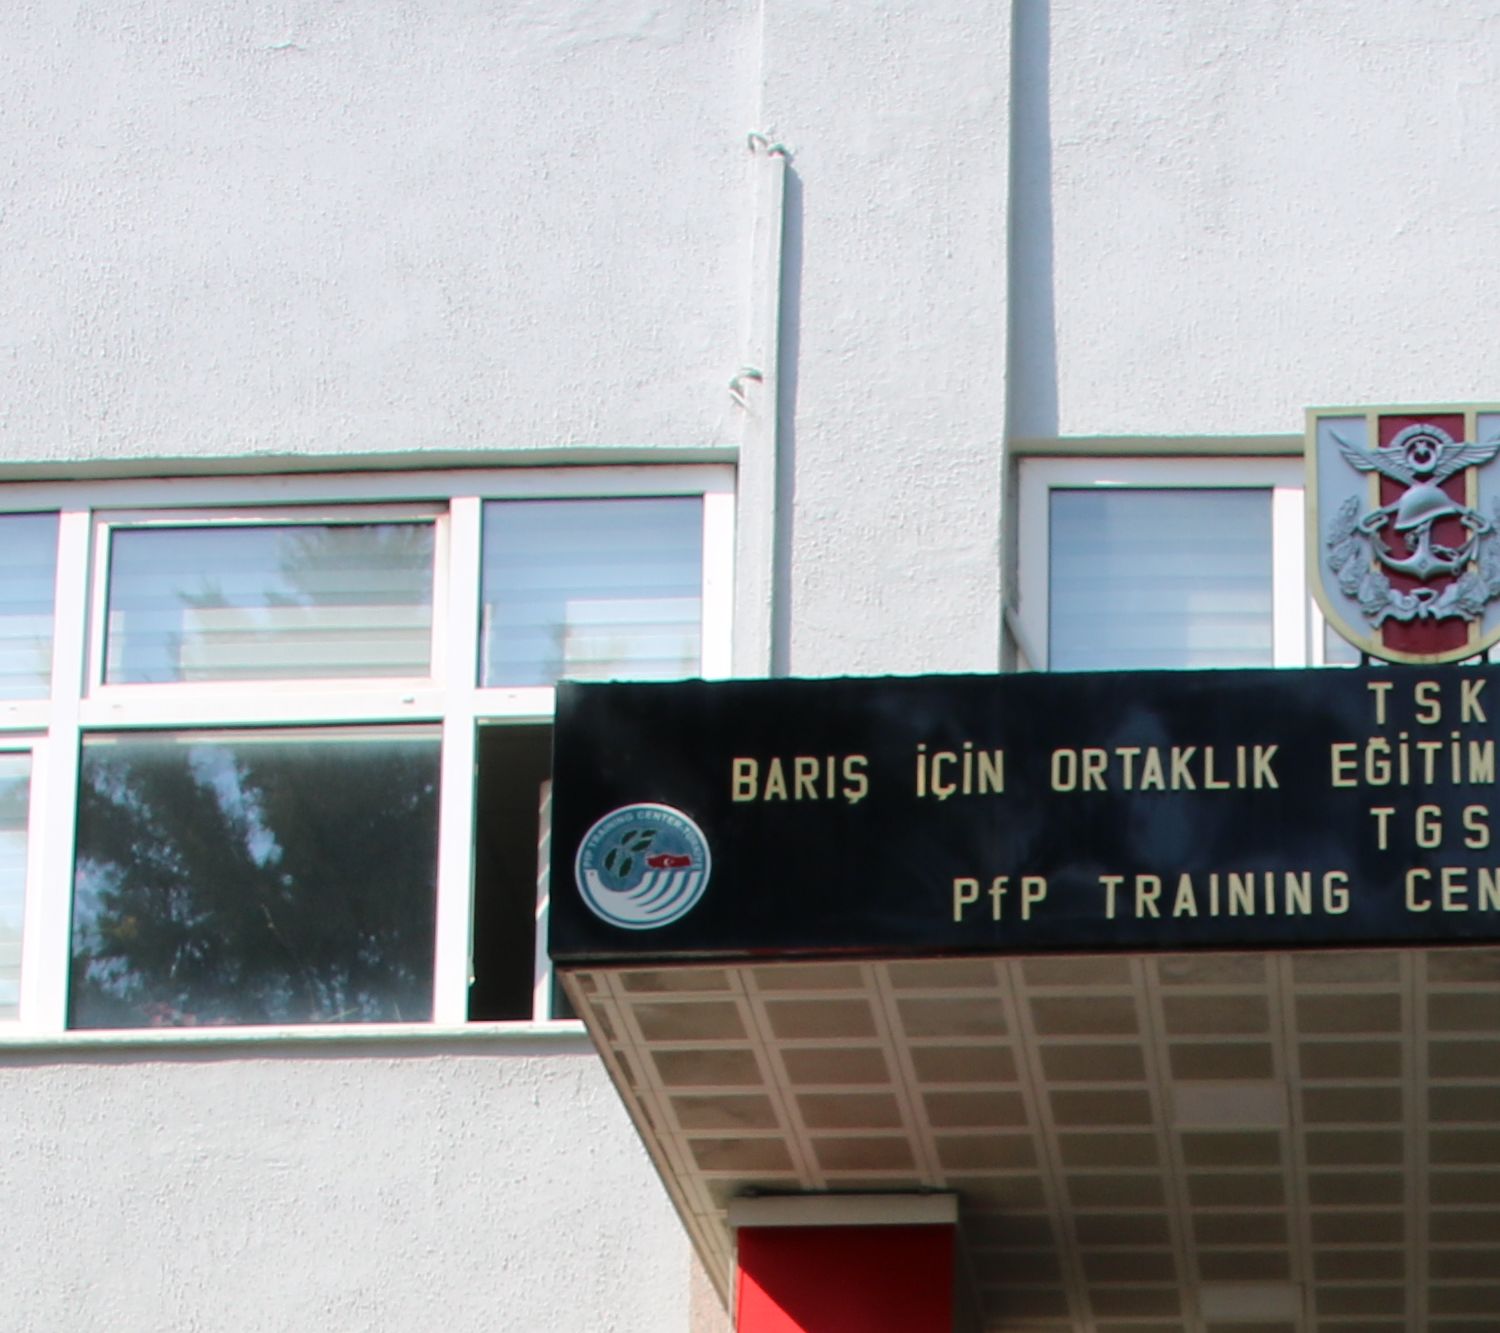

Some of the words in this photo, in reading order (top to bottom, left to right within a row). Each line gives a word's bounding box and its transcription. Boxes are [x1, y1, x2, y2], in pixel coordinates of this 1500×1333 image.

[1367, 679, 1487, 725] TSK
[732, 755, 868, 804] BARIŞ
[917, 742, 1004, 801] İÇİN
[1051, 745, 1279, 792] ORTAKLIK
[1331, 731, 1495, 787] EĞİTİM
[588, 813, 634, 847] TRAINING
[637, 810, 683, 827] CENTER
[1370, 805, 1490, 850] TGS
[954, 876, 1047, 922] PfP
[1098, 871, 1349, 919] TRAINING
